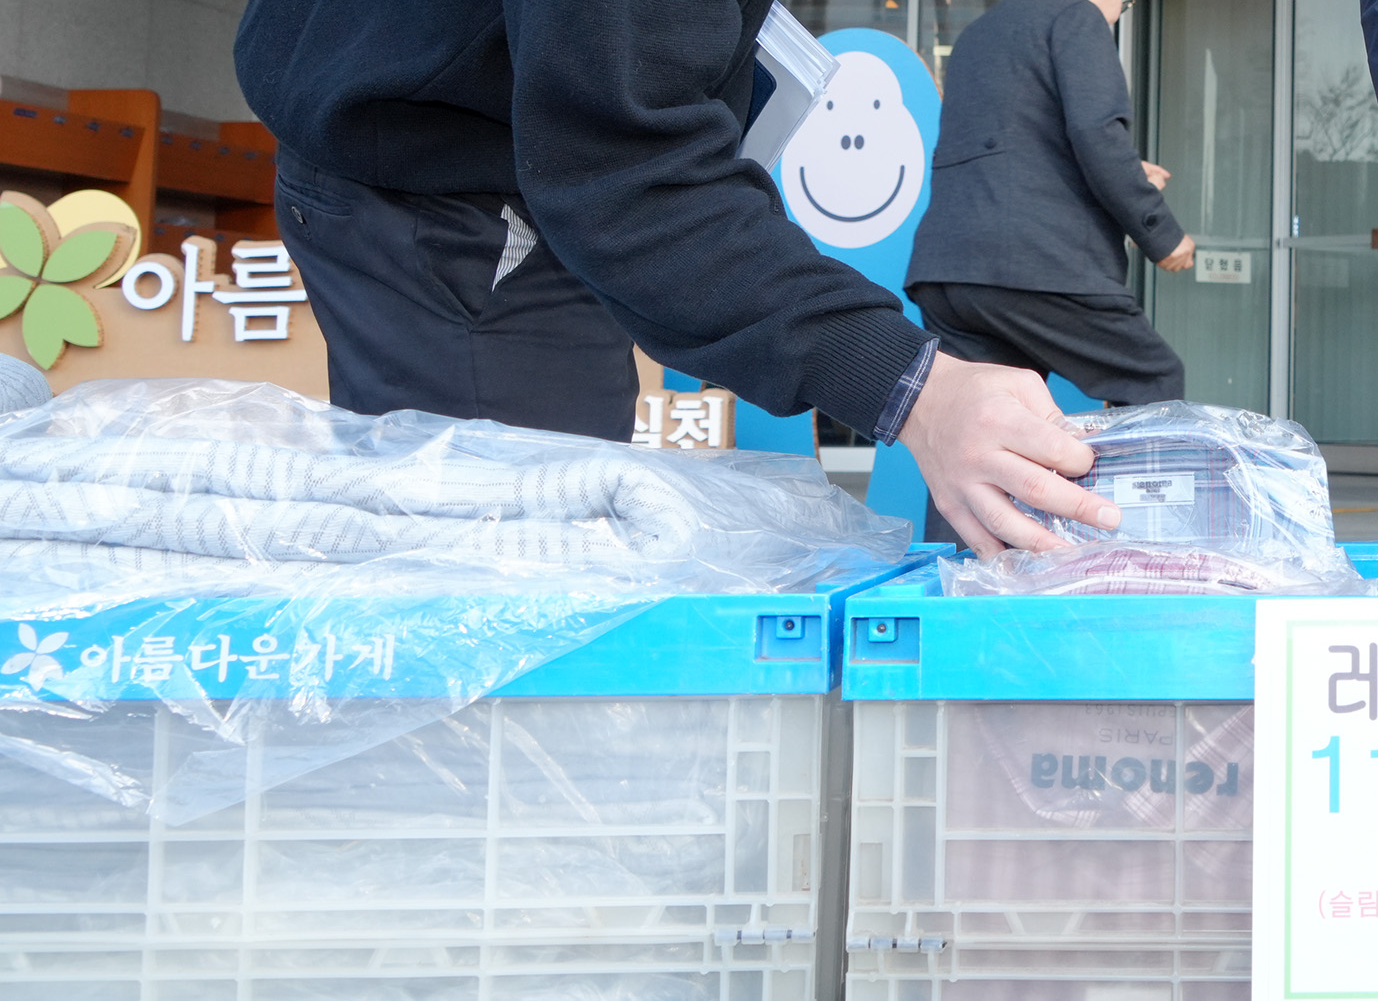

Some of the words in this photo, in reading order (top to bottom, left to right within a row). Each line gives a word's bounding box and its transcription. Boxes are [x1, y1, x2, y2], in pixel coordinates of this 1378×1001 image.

[121, 242, 308, 343] 아름
[80, 633, 396, 683] 아름다운가게
[1098, 727, 1175, 746] PARIS
[1030, 752, 1240, 797] renoma
